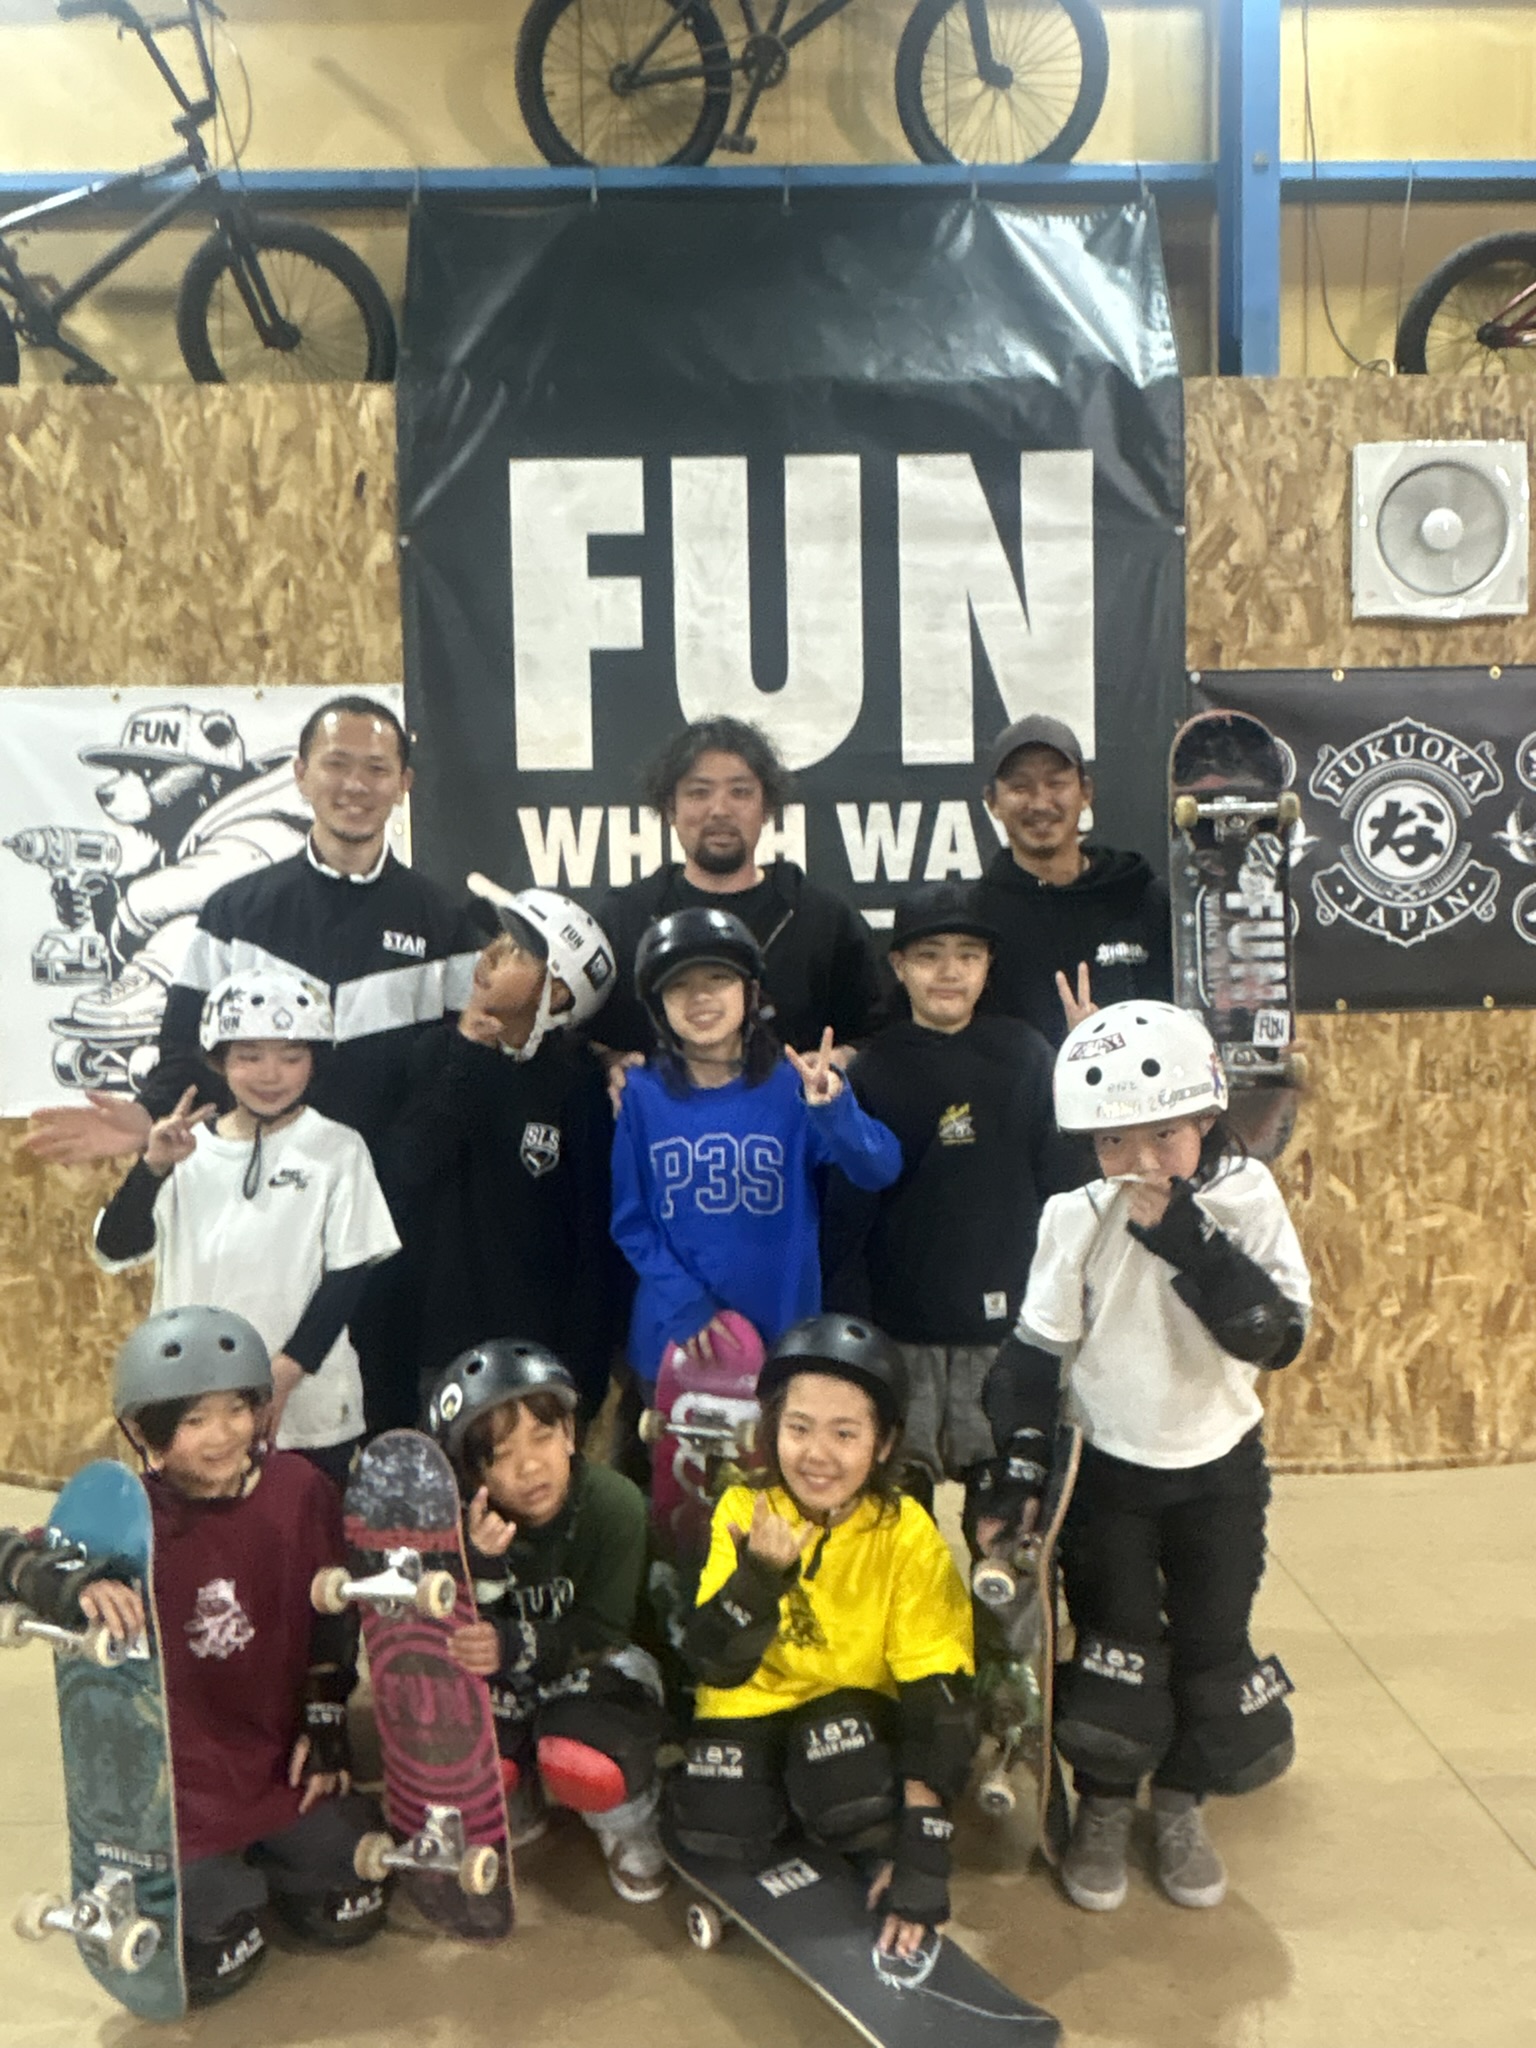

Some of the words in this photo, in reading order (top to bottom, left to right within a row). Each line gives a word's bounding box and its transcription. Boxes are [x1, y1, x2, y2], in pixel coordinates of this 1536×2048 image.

[509, 449, 1096, 771] FUN
[129, 719, 181, 748] FUN
[1323, 733, 1485, 797] FUKUOKA
[517, 803, 808, 888] WHH
[1344, 888, 1470, 931] JAPAN
[382, 930, 426, 958] STAR
[1225, 891, 1288, 1001] FUN
[650, 1132, 784, 1220] P3S
[1091, 1643, 1145, 1671] 187
[808, 1718, 860, 1748] 187
